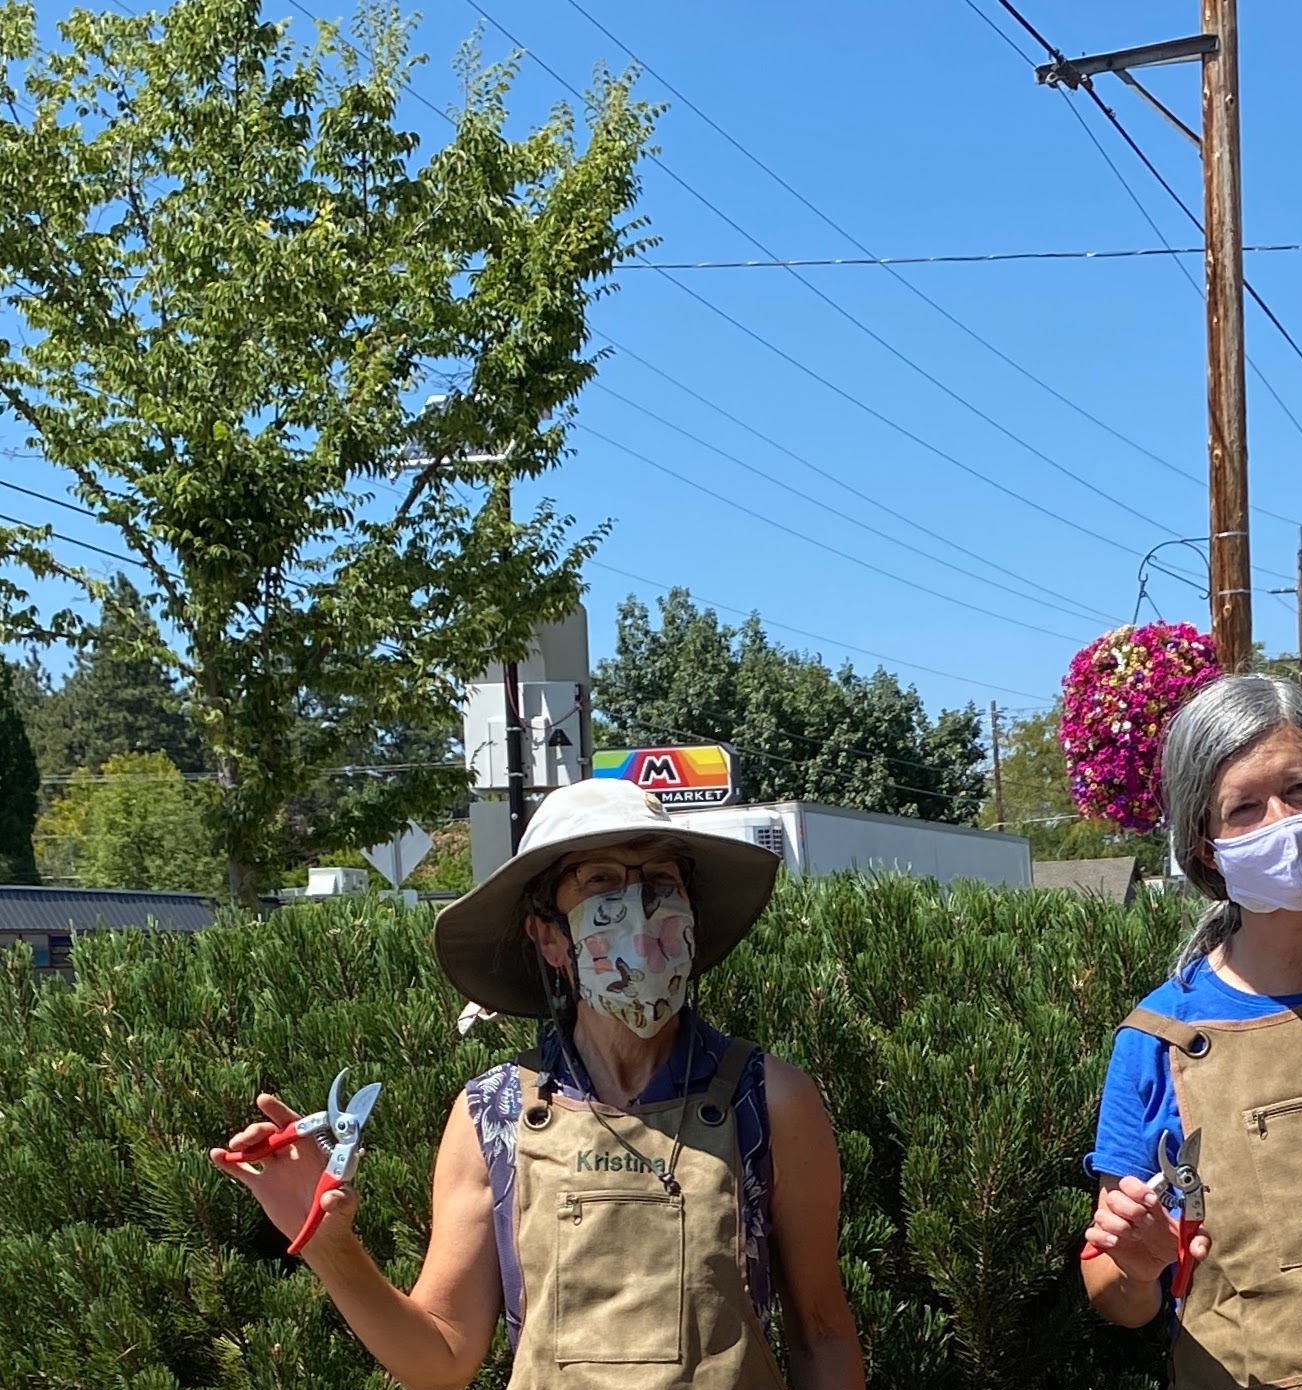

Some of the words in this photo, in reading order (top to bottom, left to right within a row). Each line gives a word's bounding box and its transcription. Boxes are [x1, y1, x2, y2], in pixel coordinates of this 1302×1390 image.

[639, 754, 681, 785] M
[661, 790, 724, 802] MARKET
[576, 1149, 666, 1174] Kristina
